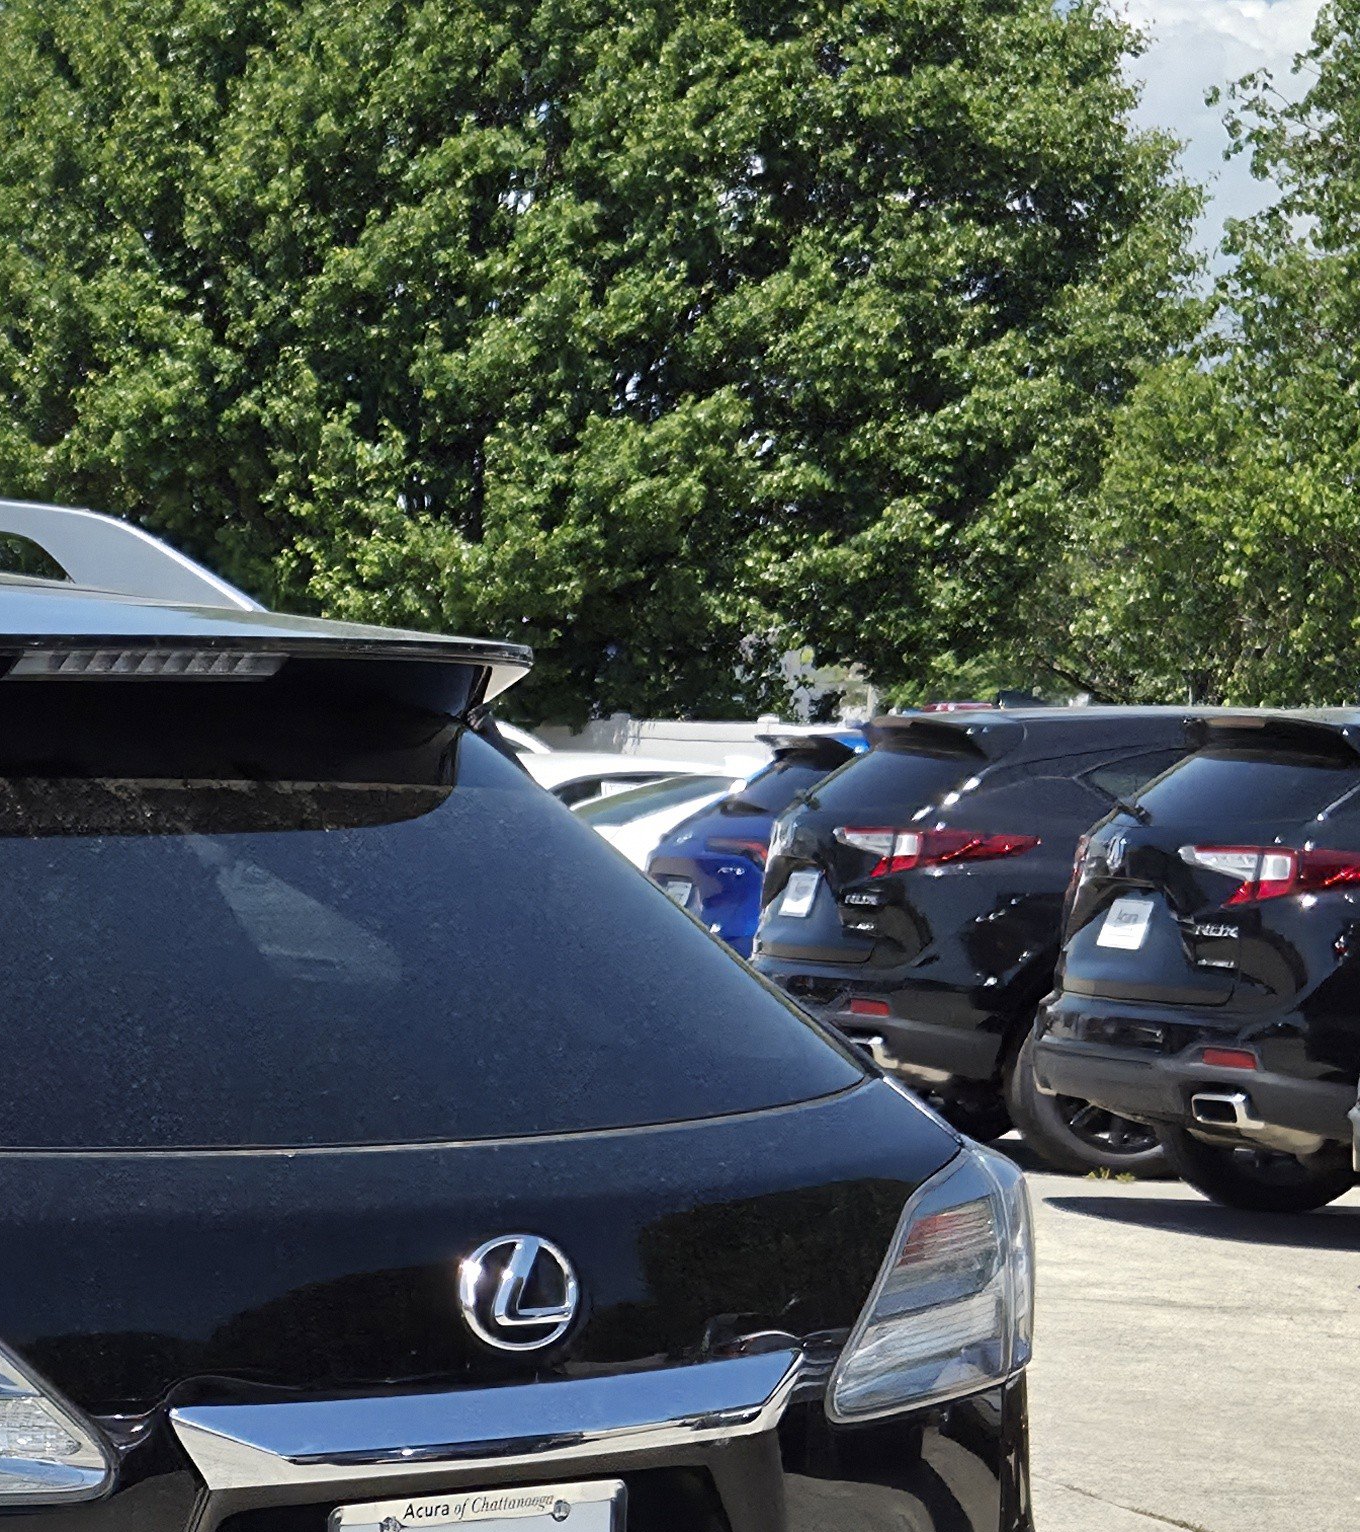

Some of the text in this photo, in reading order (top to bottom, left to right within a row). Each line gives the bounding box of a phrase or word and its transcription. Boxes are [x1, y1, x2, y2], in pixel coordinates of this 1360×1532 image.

[403, 1494, 554, 1520] Acura of Chattanooga
